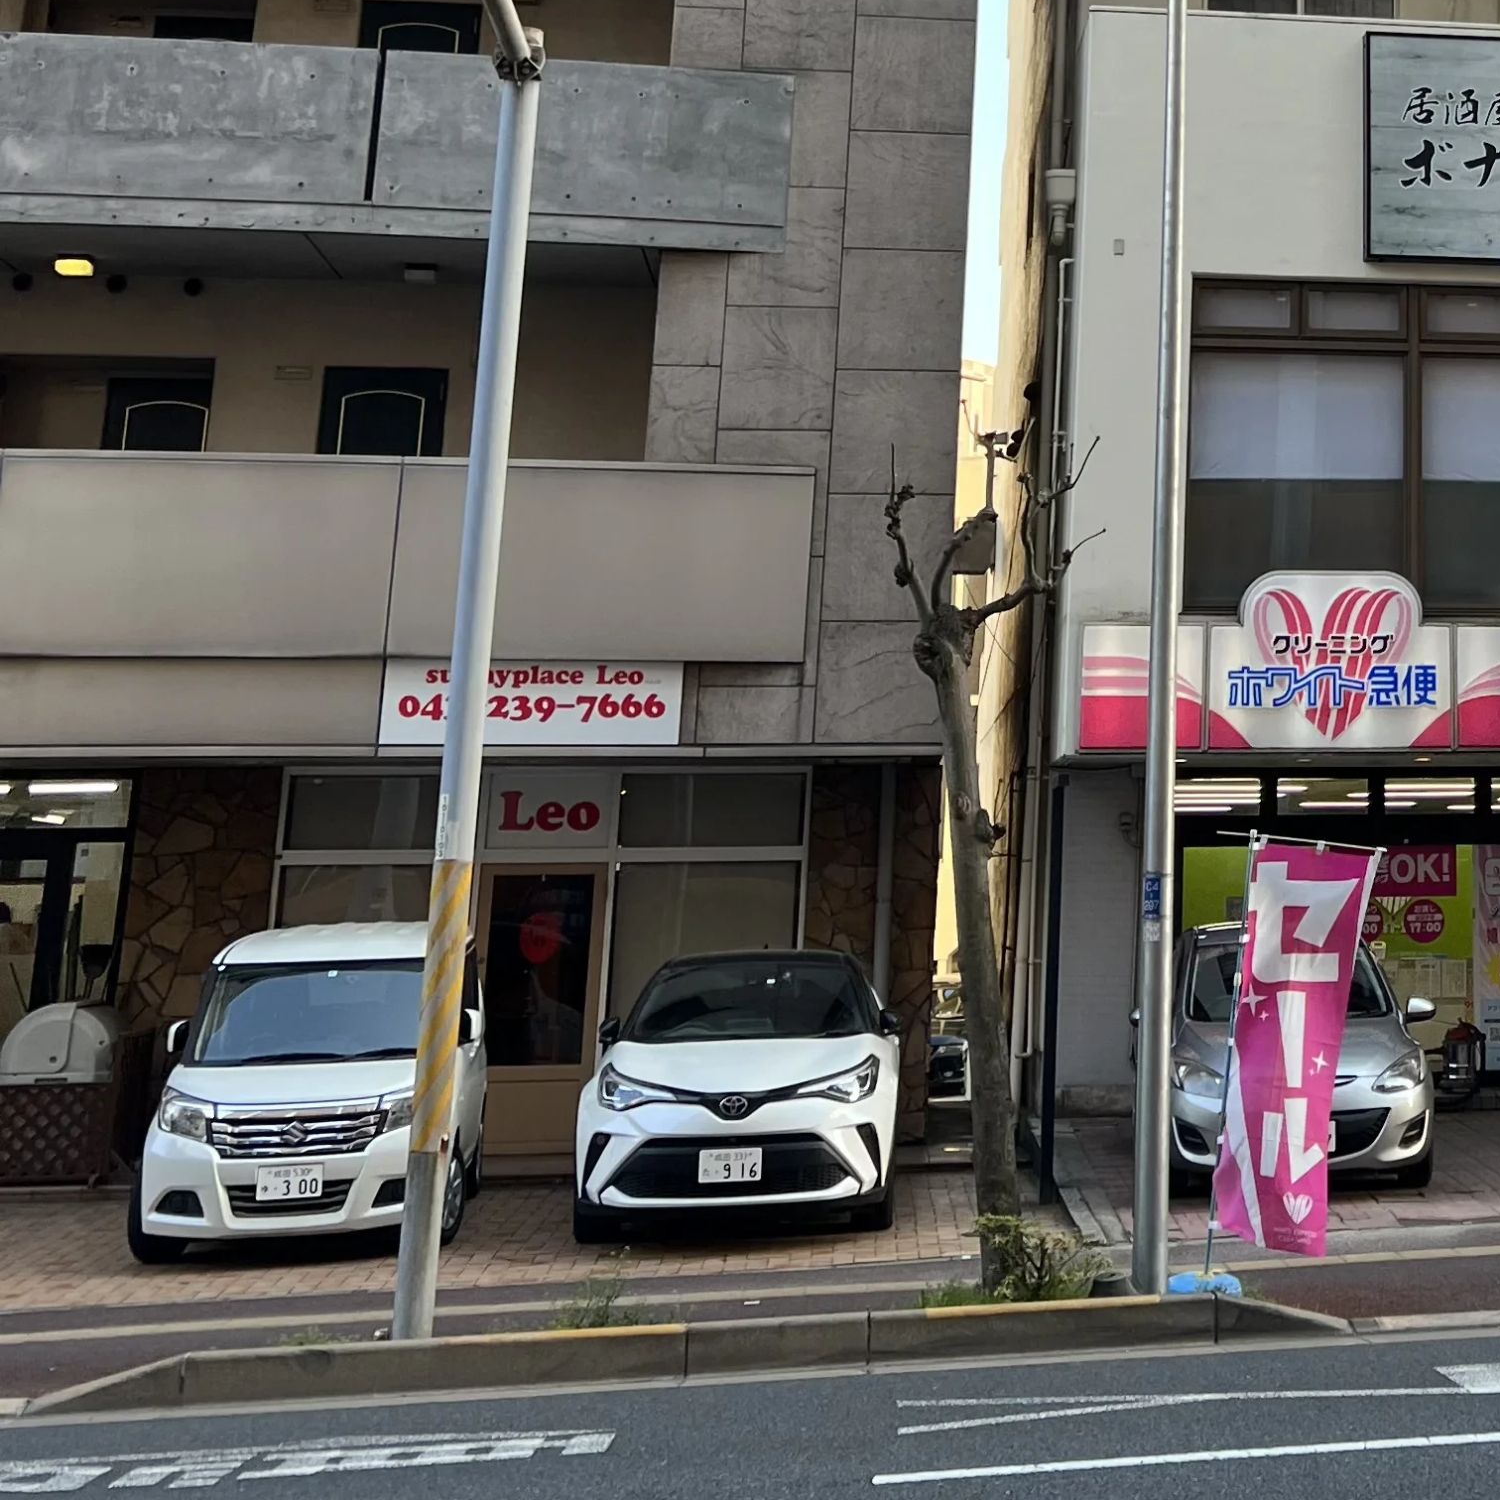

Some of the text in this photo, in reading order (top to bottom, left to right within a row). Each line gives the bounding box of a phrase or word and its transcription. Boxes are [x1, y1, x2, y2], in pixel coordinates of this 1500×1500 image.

[1273, 634, 1394, 654] クリーニング
[596, 665, 644, 685] Leo
[1228, 665, 1437, 707] ホワイト急便
[398, 693, 666, 723] 04239-7666
[498, 790, 601, 832] Leo
[1410, 922, 1442, 934] 17:00
[1248, 861, 1361, 1184] セール
